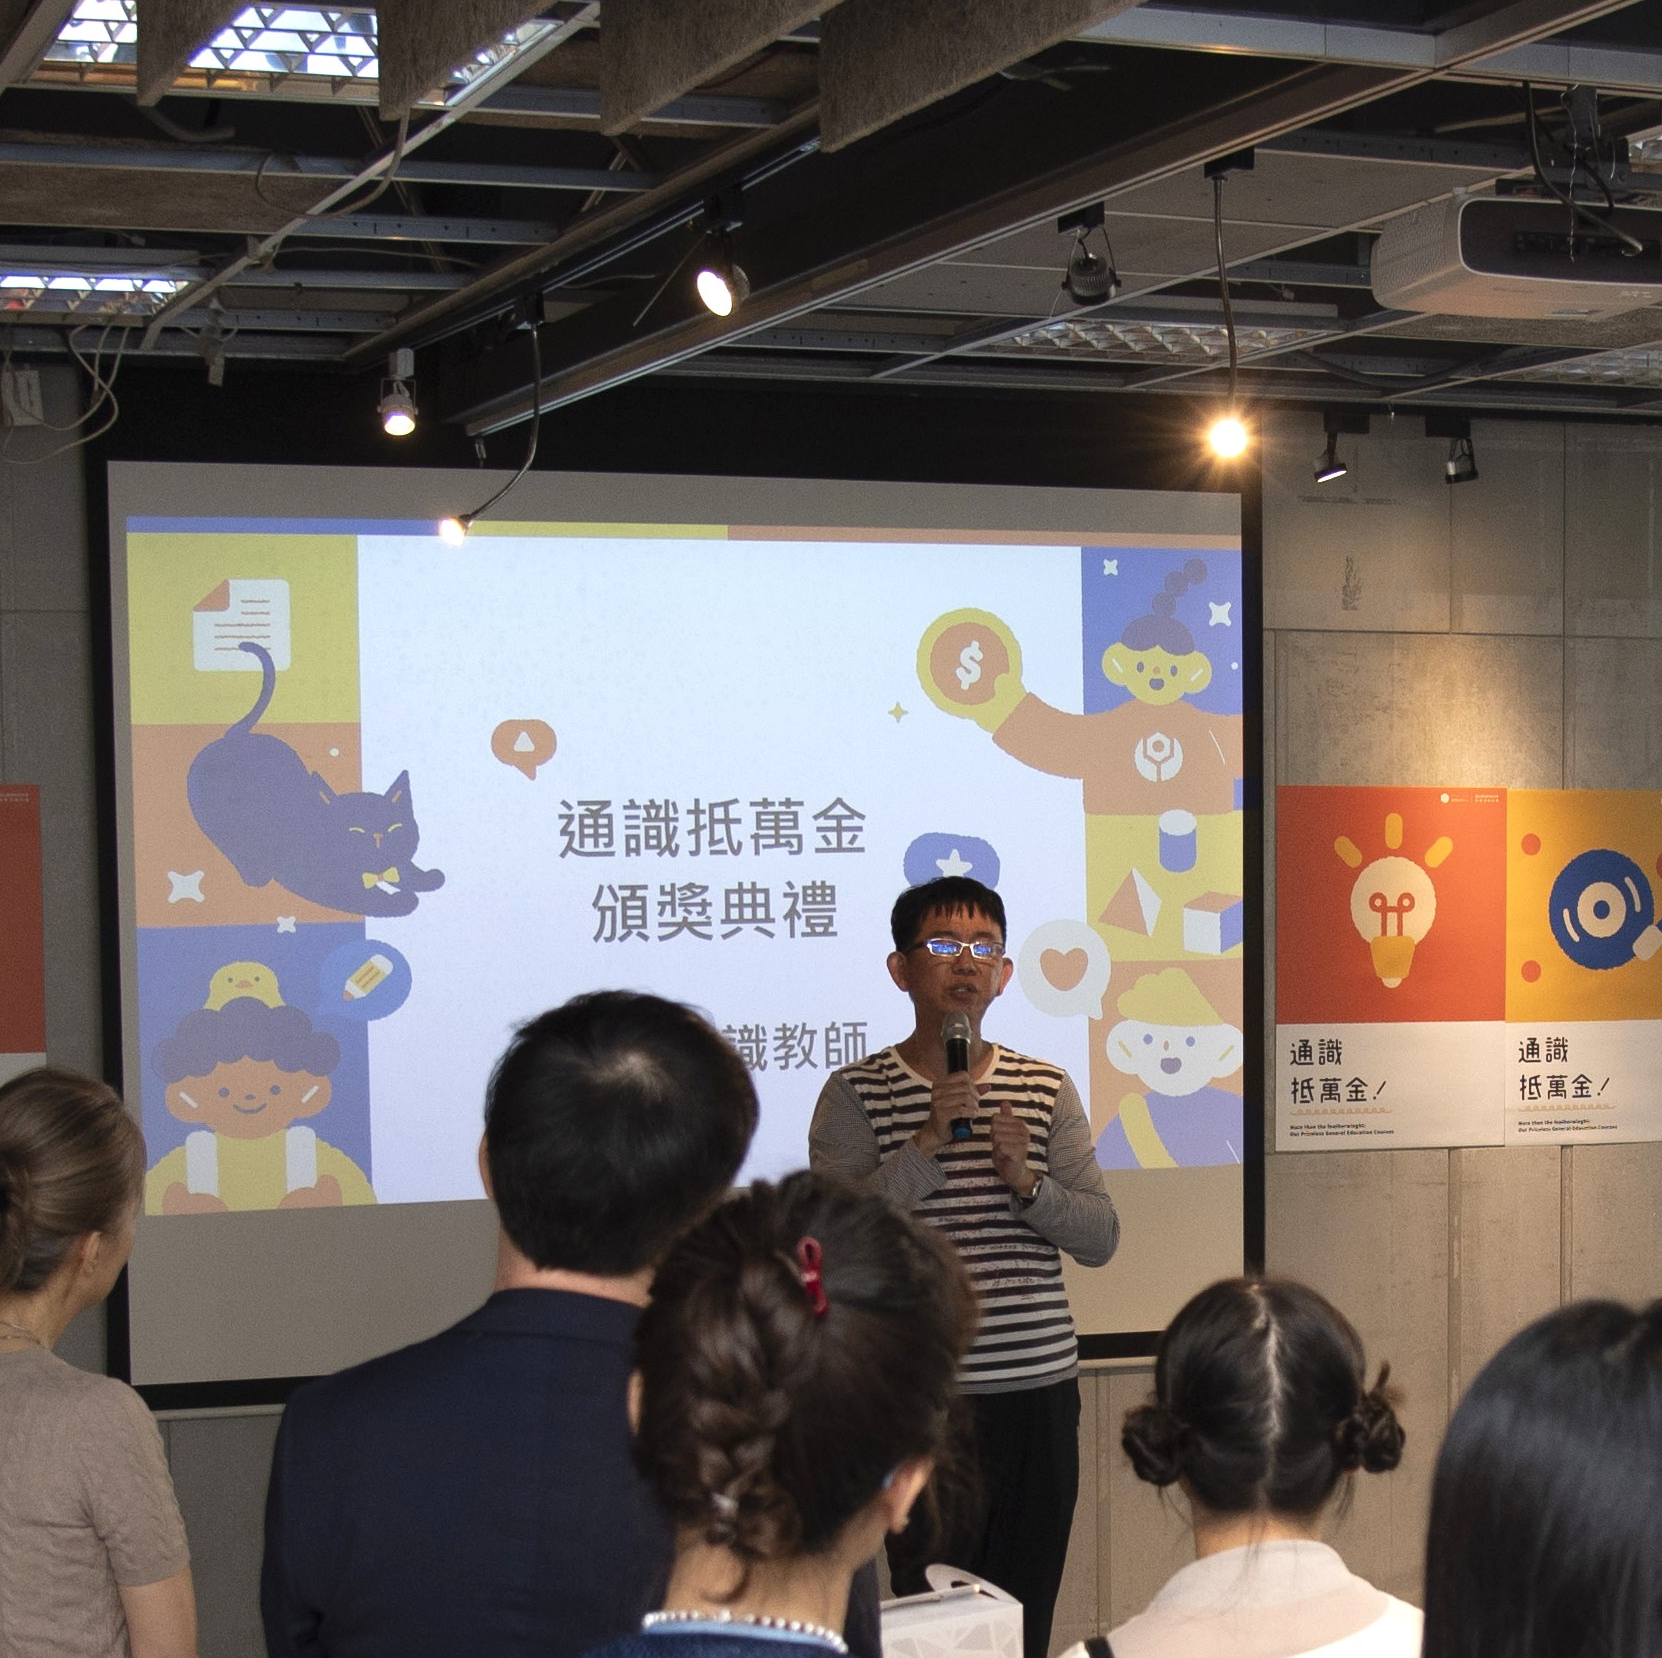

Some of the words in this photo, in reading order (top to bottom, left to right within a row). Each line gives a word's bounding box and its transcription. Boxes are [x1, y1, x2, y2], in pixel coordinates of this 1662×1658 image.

[557, 796, 867, 859] 通識抵萬金
[591, 880, 838, 943] 頒獎典禮
[1290, 1038, 1342, 1066] 通識
[1518, 1037, 1568, 1063] 通識
